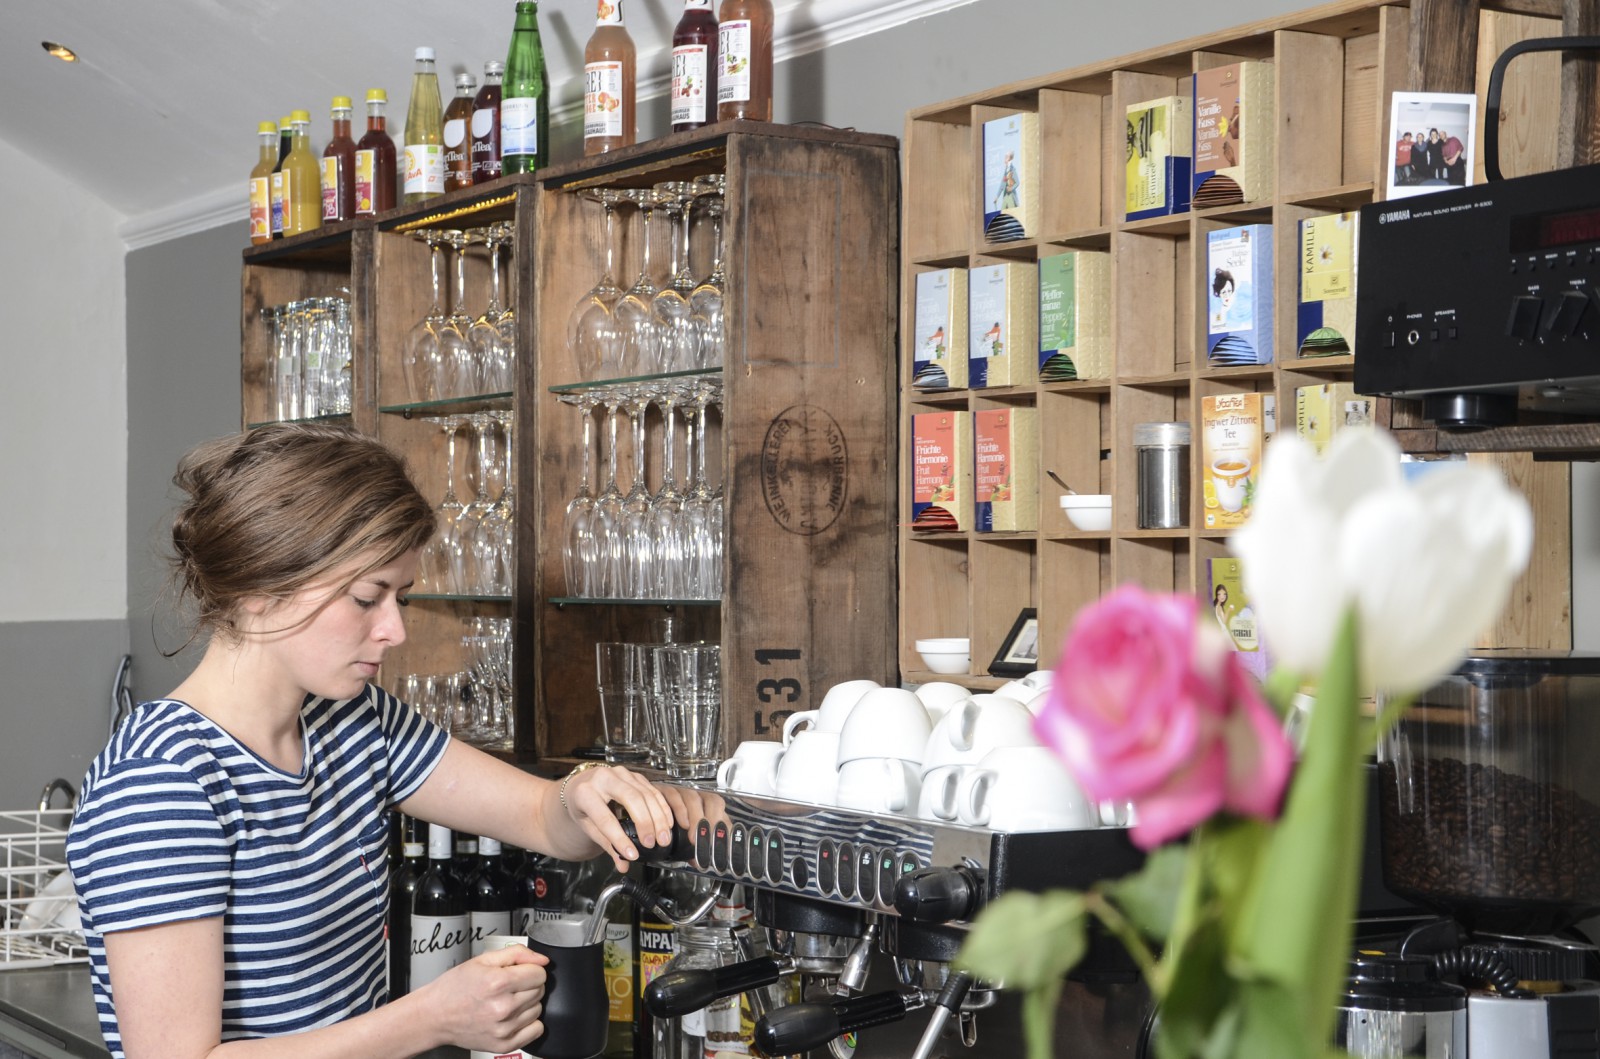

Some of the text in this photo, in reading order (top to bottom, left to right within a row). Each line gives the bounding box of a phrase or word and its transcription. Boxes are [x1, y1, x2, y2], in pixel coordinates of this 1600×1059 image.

[1387, 209, 1411, 223] YAMAHA
[1412, 211, 1433, 219] NATURAL
[1433, 207, 1450, 215] SOUND
[1450, 204, 1472, 212] RECEIVER
[1306, 221, 1315, 274] KAMILLE
[1204, 415, 1257, 429] Ingwer Zitrone
[1223, 428, 1237, 438] Tee
[916, 445, 942, 455] Früchte
[916, 454, 949, 465] Harmonie
[755, 649, 802, 736] 531
